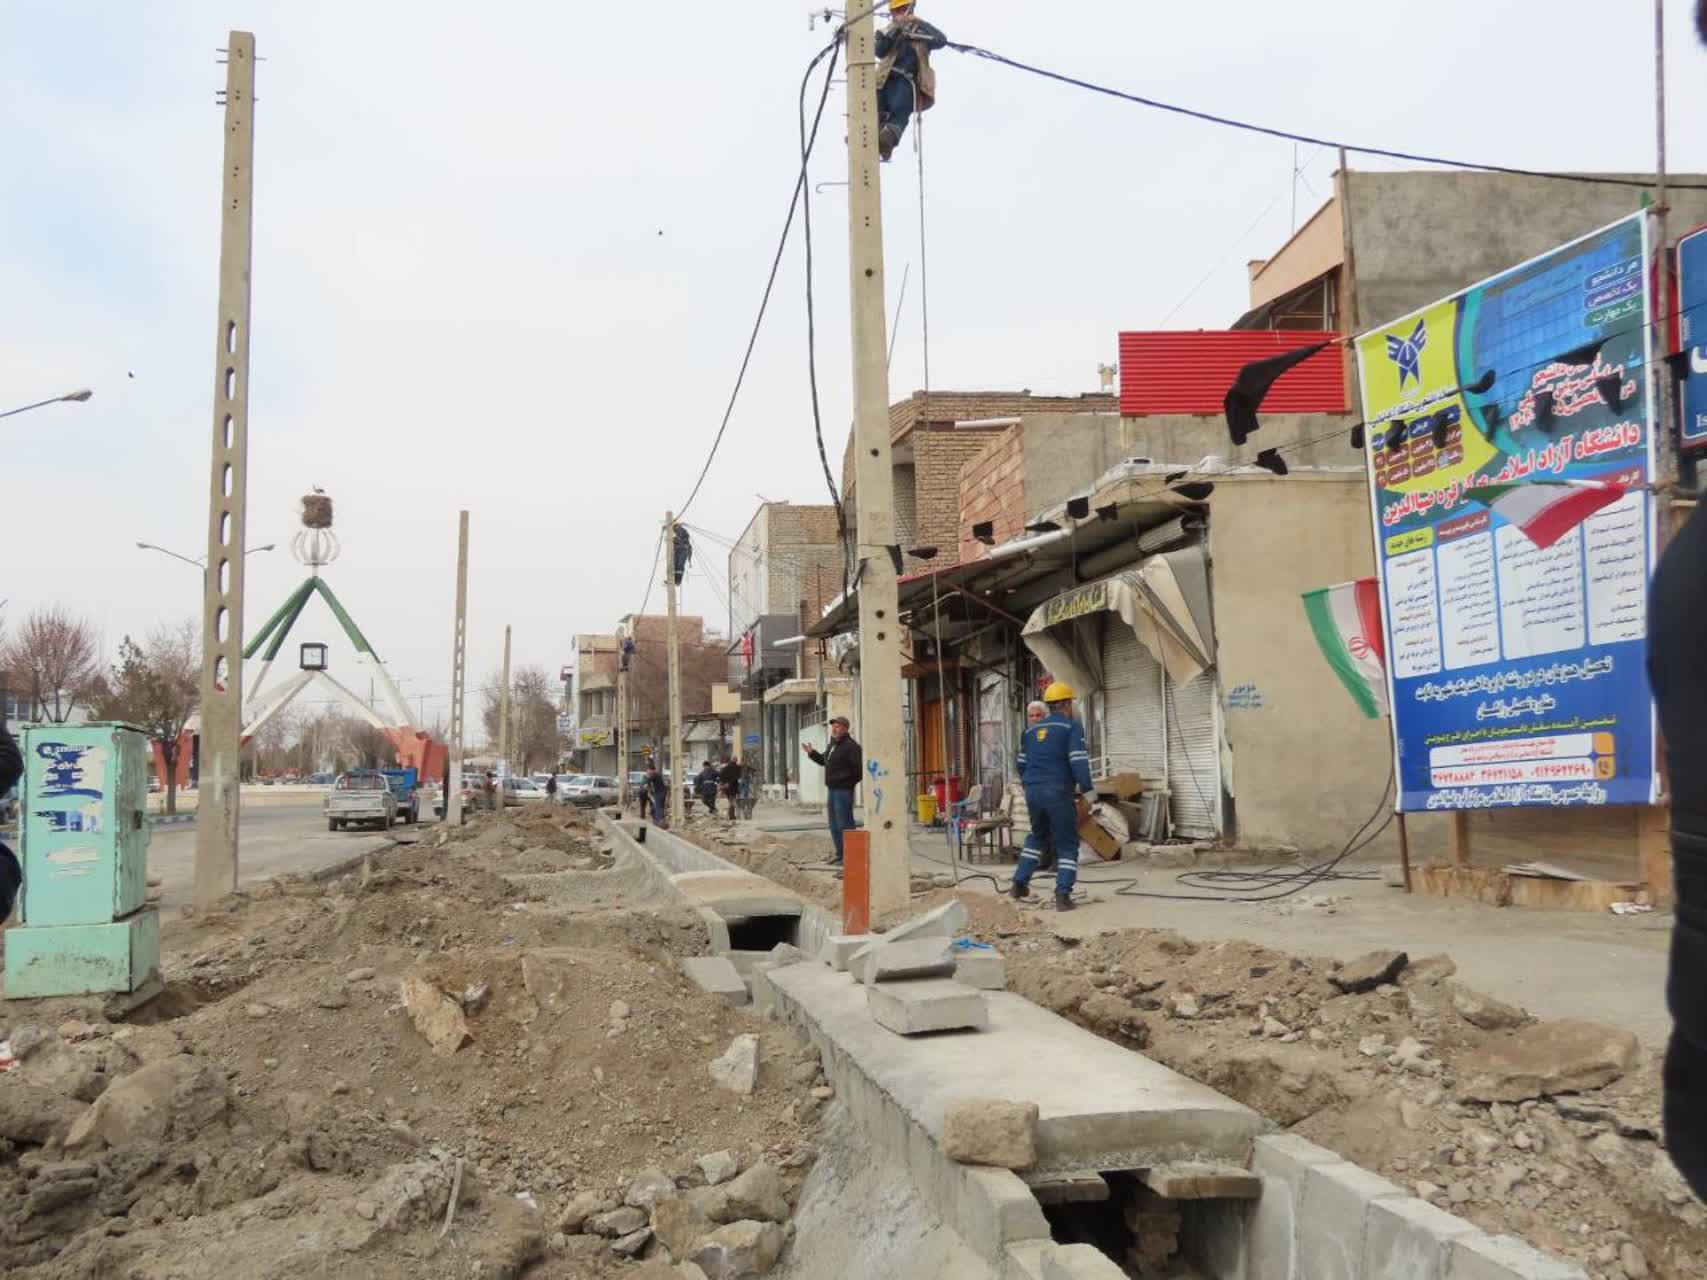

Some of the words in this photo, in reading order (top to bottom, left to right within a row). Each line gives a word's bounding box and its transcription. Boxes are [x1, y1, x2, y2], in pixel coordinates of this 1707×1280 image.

[1536, 434, 1575, 473] آزاد
[1574, 420, 1640, 459] دانشگاه
[1436, 480, 1459, 509] قره
